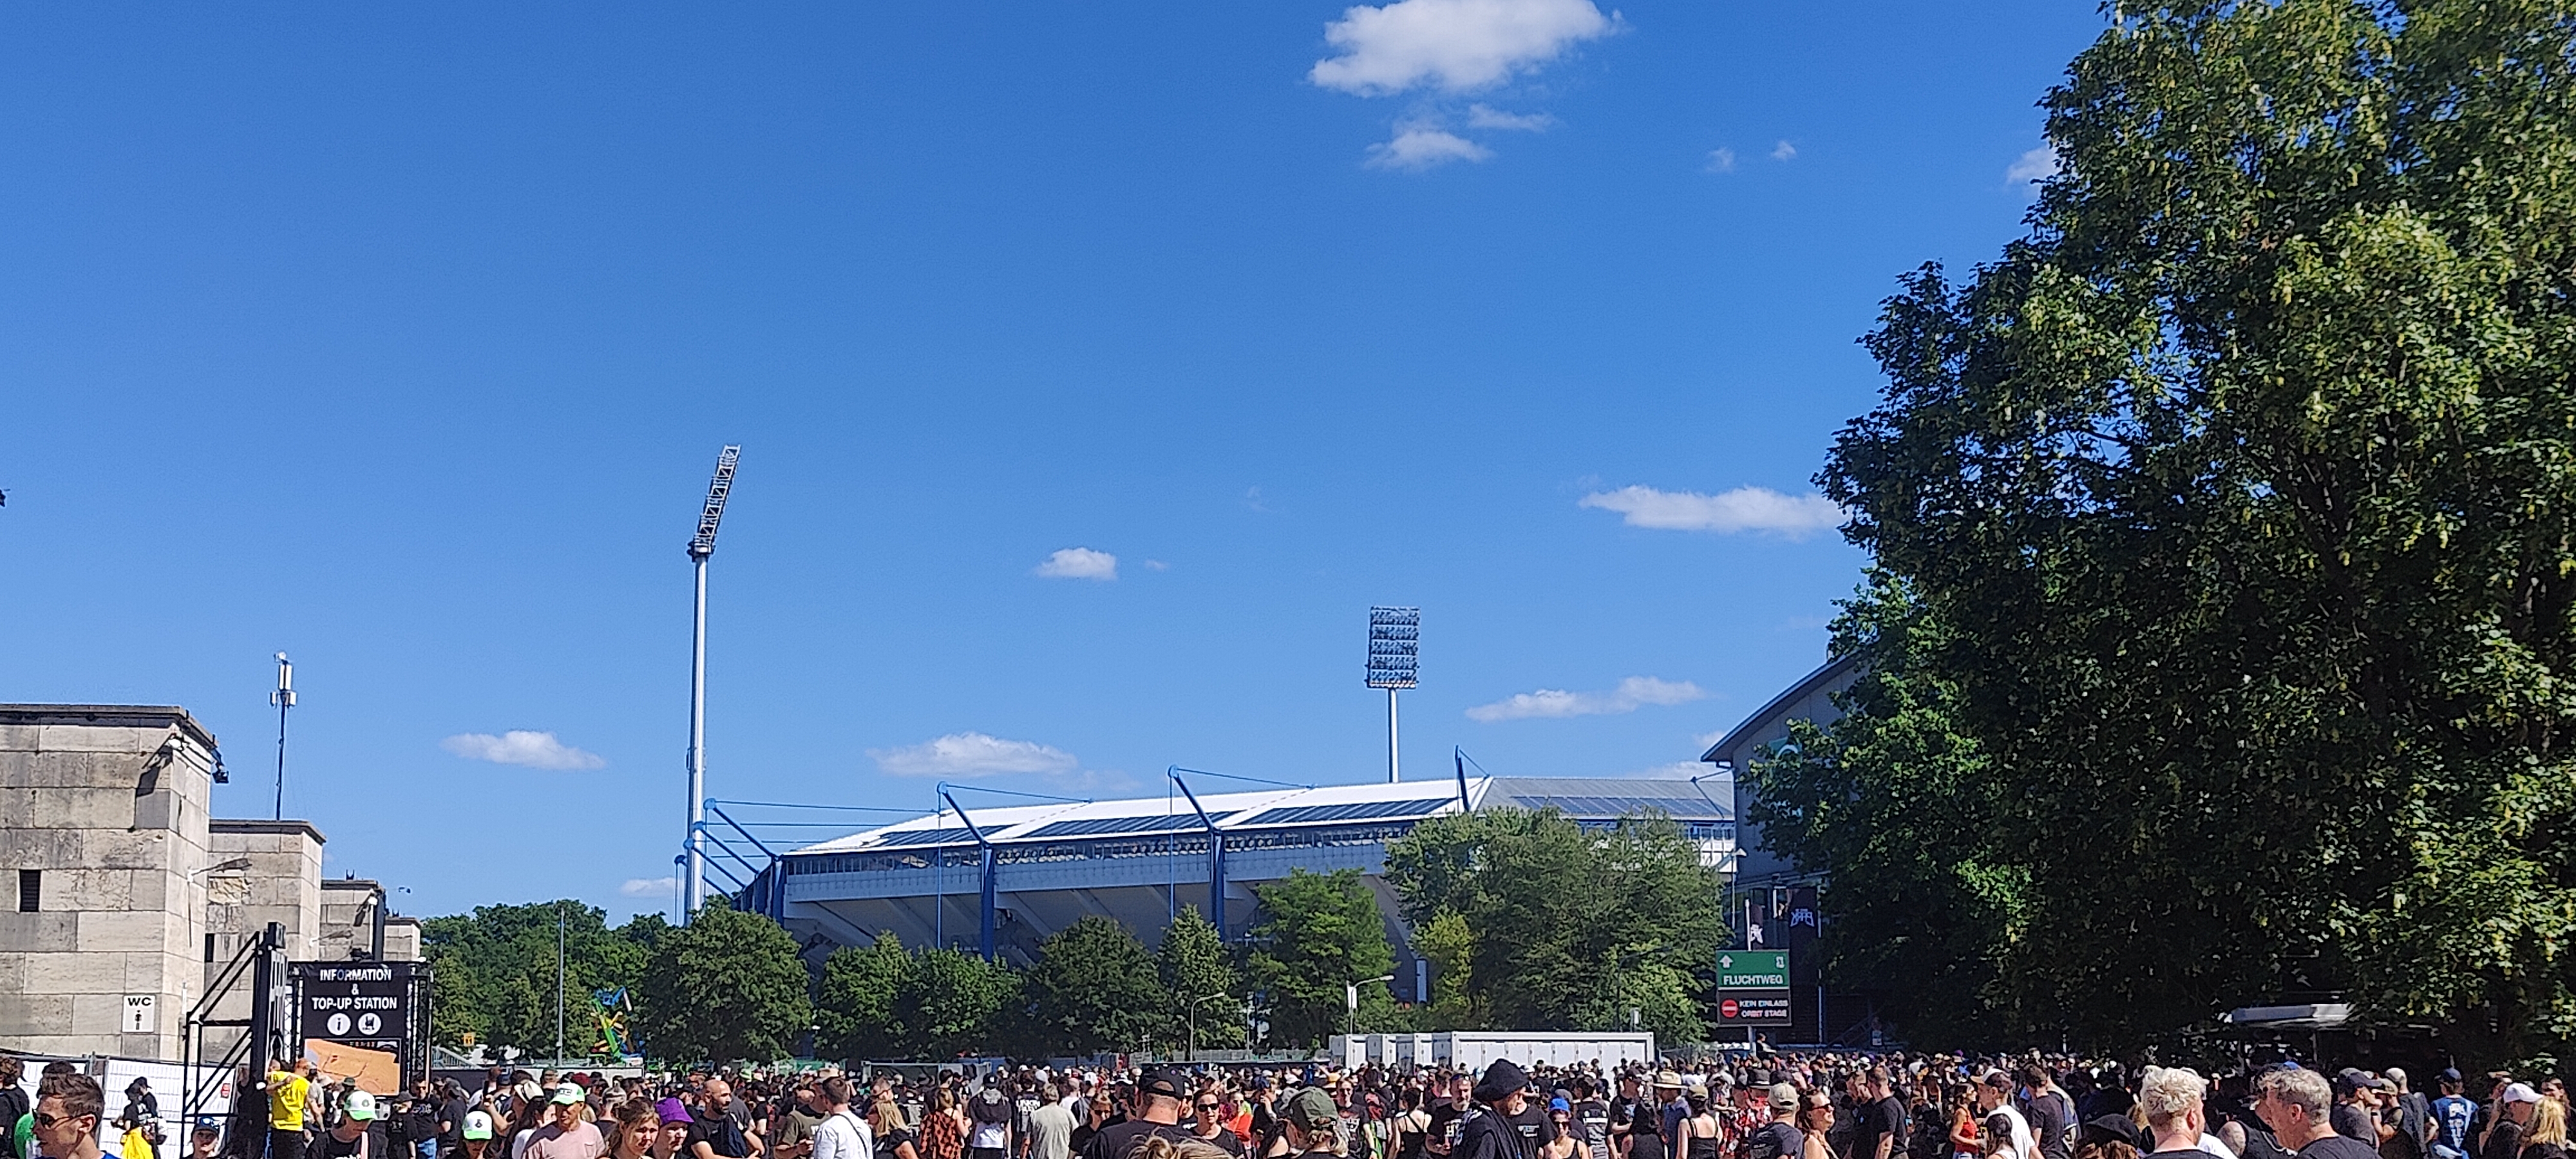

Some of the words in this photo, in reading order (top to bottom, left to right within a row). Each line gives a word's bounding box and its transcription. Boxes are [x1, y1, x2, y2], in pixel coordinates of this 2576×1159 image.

[320, 969, 392, 981] INFORMATION
[1723, 975, 1783, 985] FLUCHTWEG
[351, 983, 359, 995] &
[128, 997, 152, 1006] WC
[312, 997, 352, 1010] TOP-UP
[354, 997, 397, 1010] STATION
